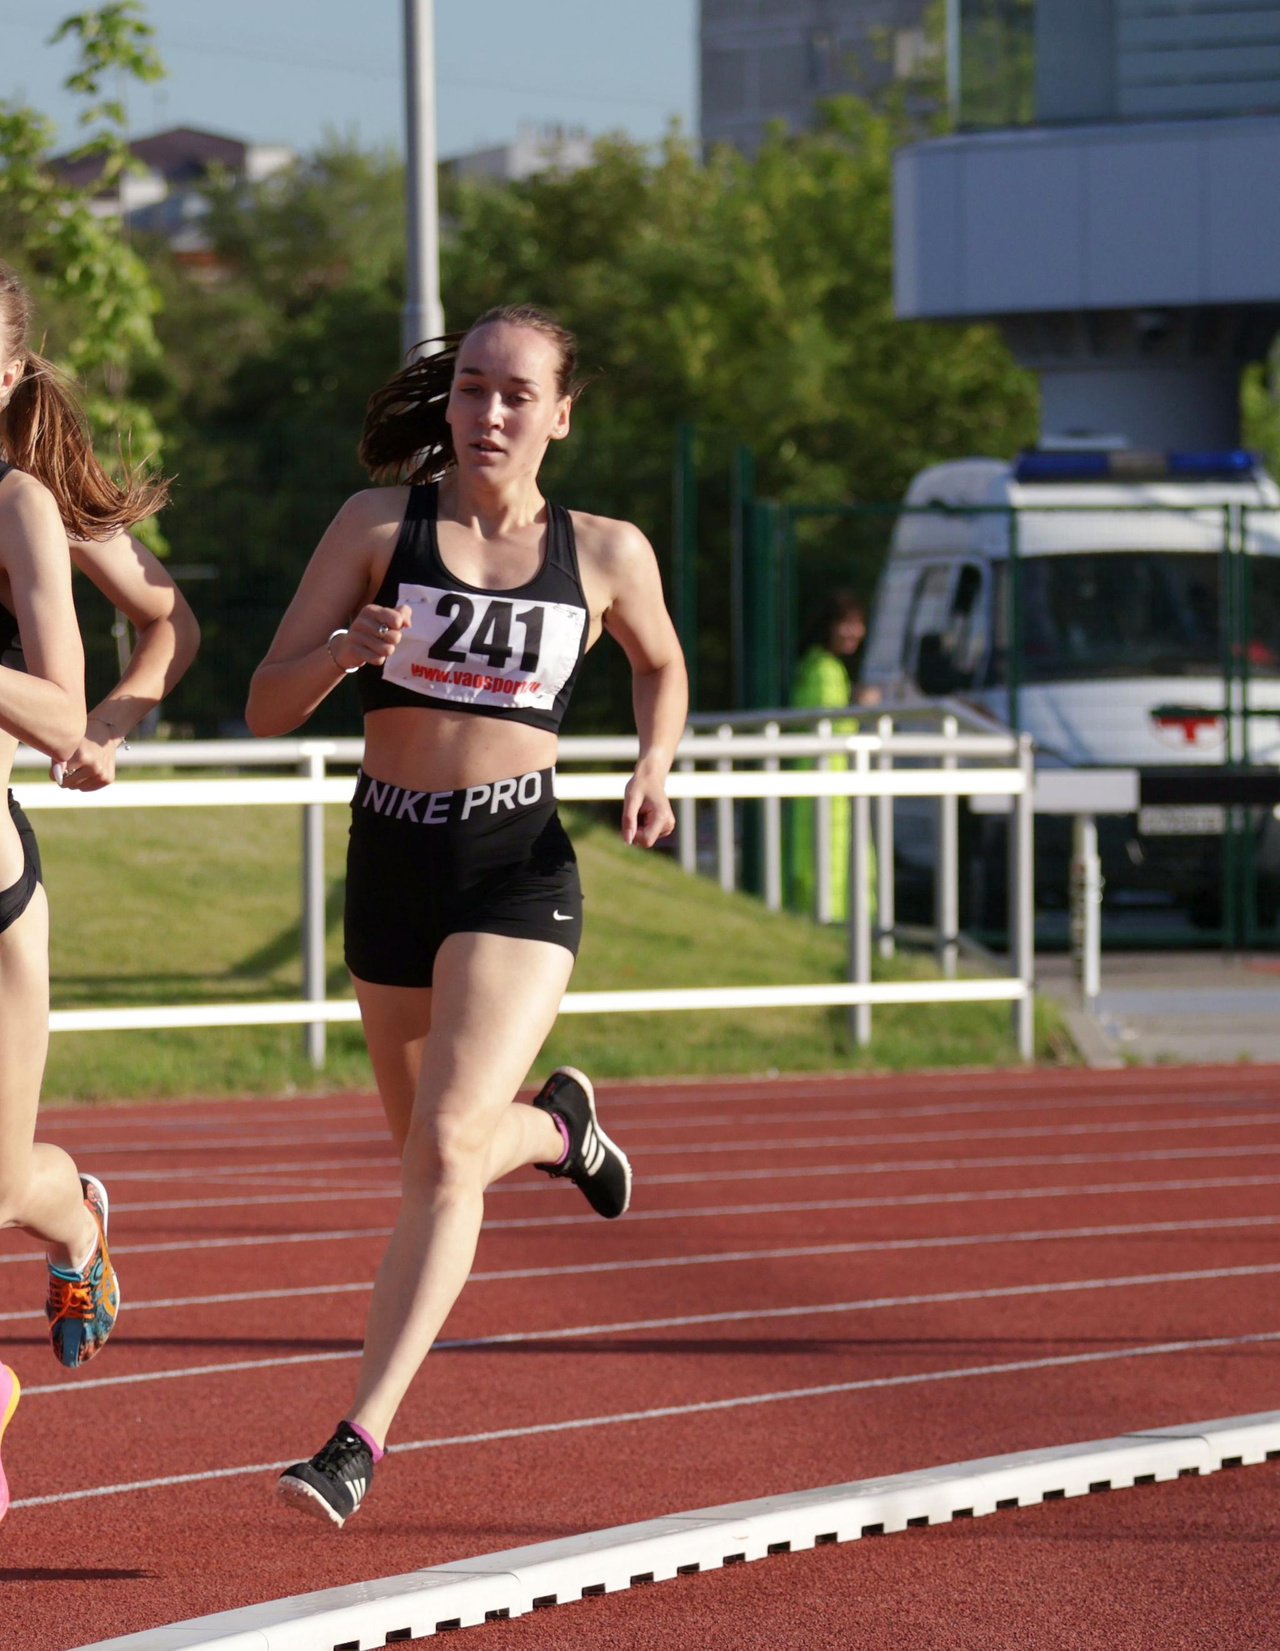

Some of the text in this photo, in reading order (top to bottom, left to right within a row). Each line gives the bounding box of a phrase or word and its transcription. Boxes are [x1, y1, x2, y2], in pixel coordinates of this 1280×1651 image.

[428, 593, 545, 673] 241
[362, 780, 454, 824] NIKE
[460, 771, 542, 821] PRO
